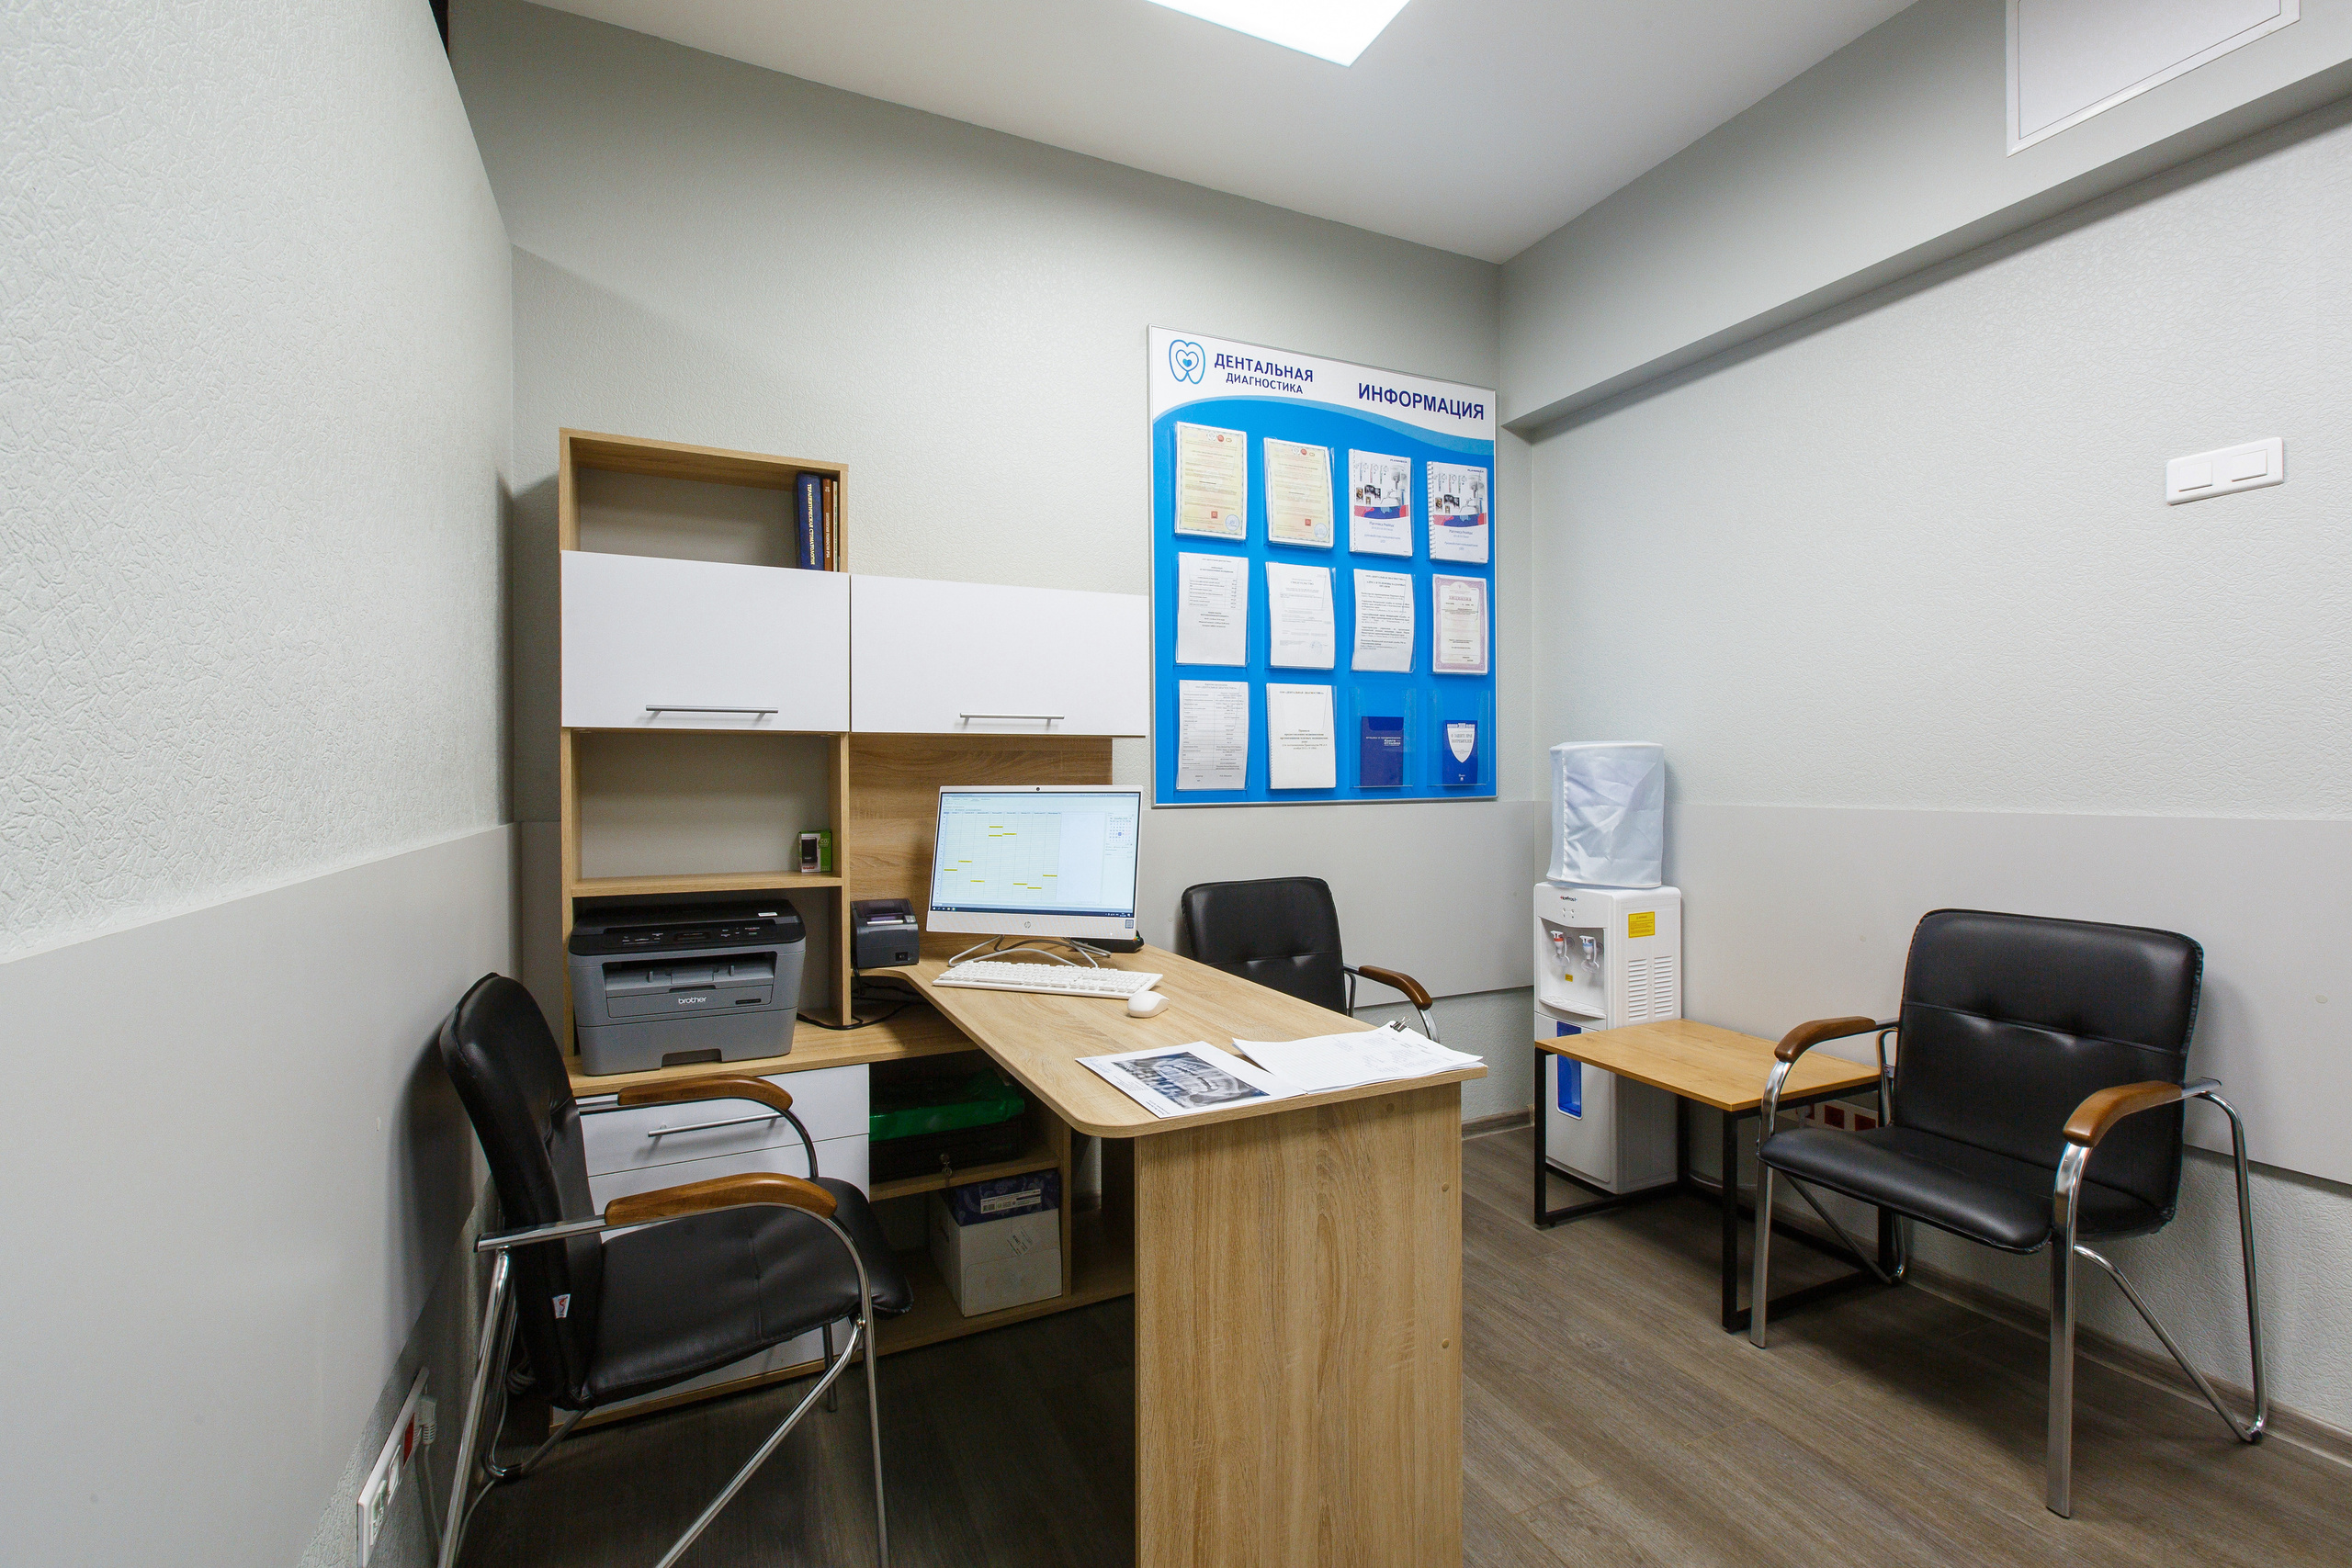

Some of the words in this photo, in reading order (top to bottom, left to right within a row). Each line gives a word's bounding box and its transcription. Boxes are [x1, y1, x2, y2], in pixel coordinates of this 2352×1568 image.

[1214, 353, 1314, 383] ДЕНТАЛЬНАЯ
[1226, 372, 1304, 394] ДИАГНОСТИКА
[1358, 382, 1485, 421] ИНФОРМАЦИЯ
[678, 996, 707, 1005] brother
